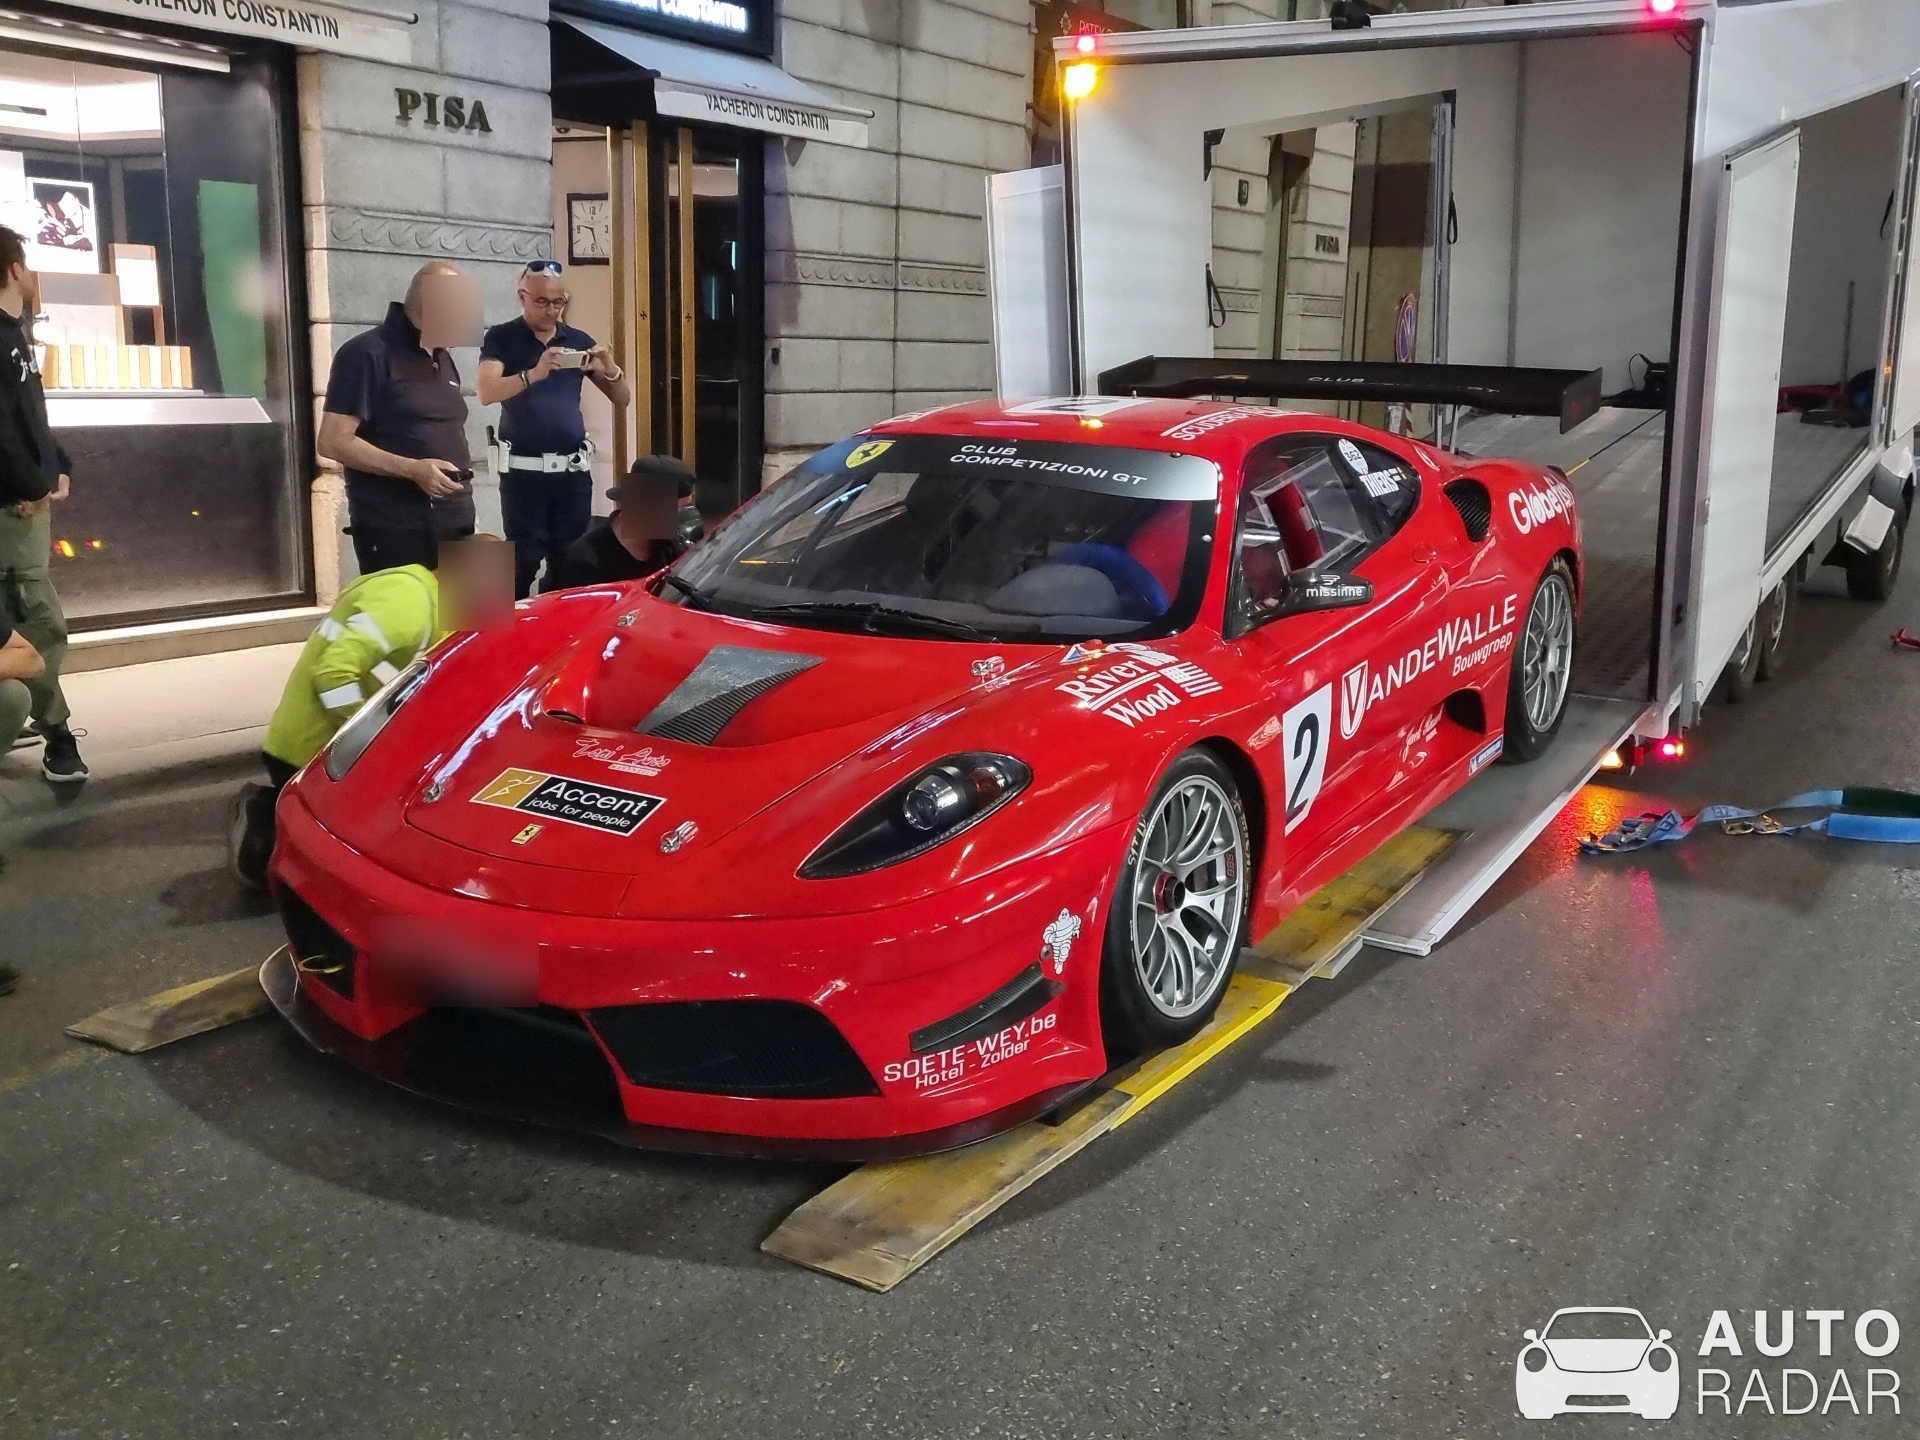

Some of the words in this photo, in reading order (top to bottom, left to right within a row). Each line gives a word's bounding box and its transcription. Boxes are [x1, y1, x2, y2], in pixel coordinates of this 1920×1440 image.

[223, 0, 339, 39] CONSTANTIN
[394, 87, 493, 132] PISA
[704, 93, 765, 120] VACHERON
[766, 105, 830, 132] CONSTANTIN
[950, 454, 1109, 478] COMPETIZIONI
[1112, 472, 1147, 485] GT
[960, 444, 1018, 456] CLUB
[1344, 449, 1362, 462] 362
[1306, 584, 1363, 597] missinne
[1452, 631, 1514, 677] Bouwgroep
[1054, 659, 1149, 701] River
[1102, 682, 1182, 728] Wood
[1286, 712, 1320, 826] 2
[525, 797, 557, 811] jobs
[560, 804, 583, 816] for
[579, 811, 631, 828] people
[541, 781, 648, 816] Accent
[884, 1013, 1057, 1083] SOETE-WEY.be
[915, 1065, 964, 1089] Hotel
[981, 1039, 1031, 1069] Zolder
